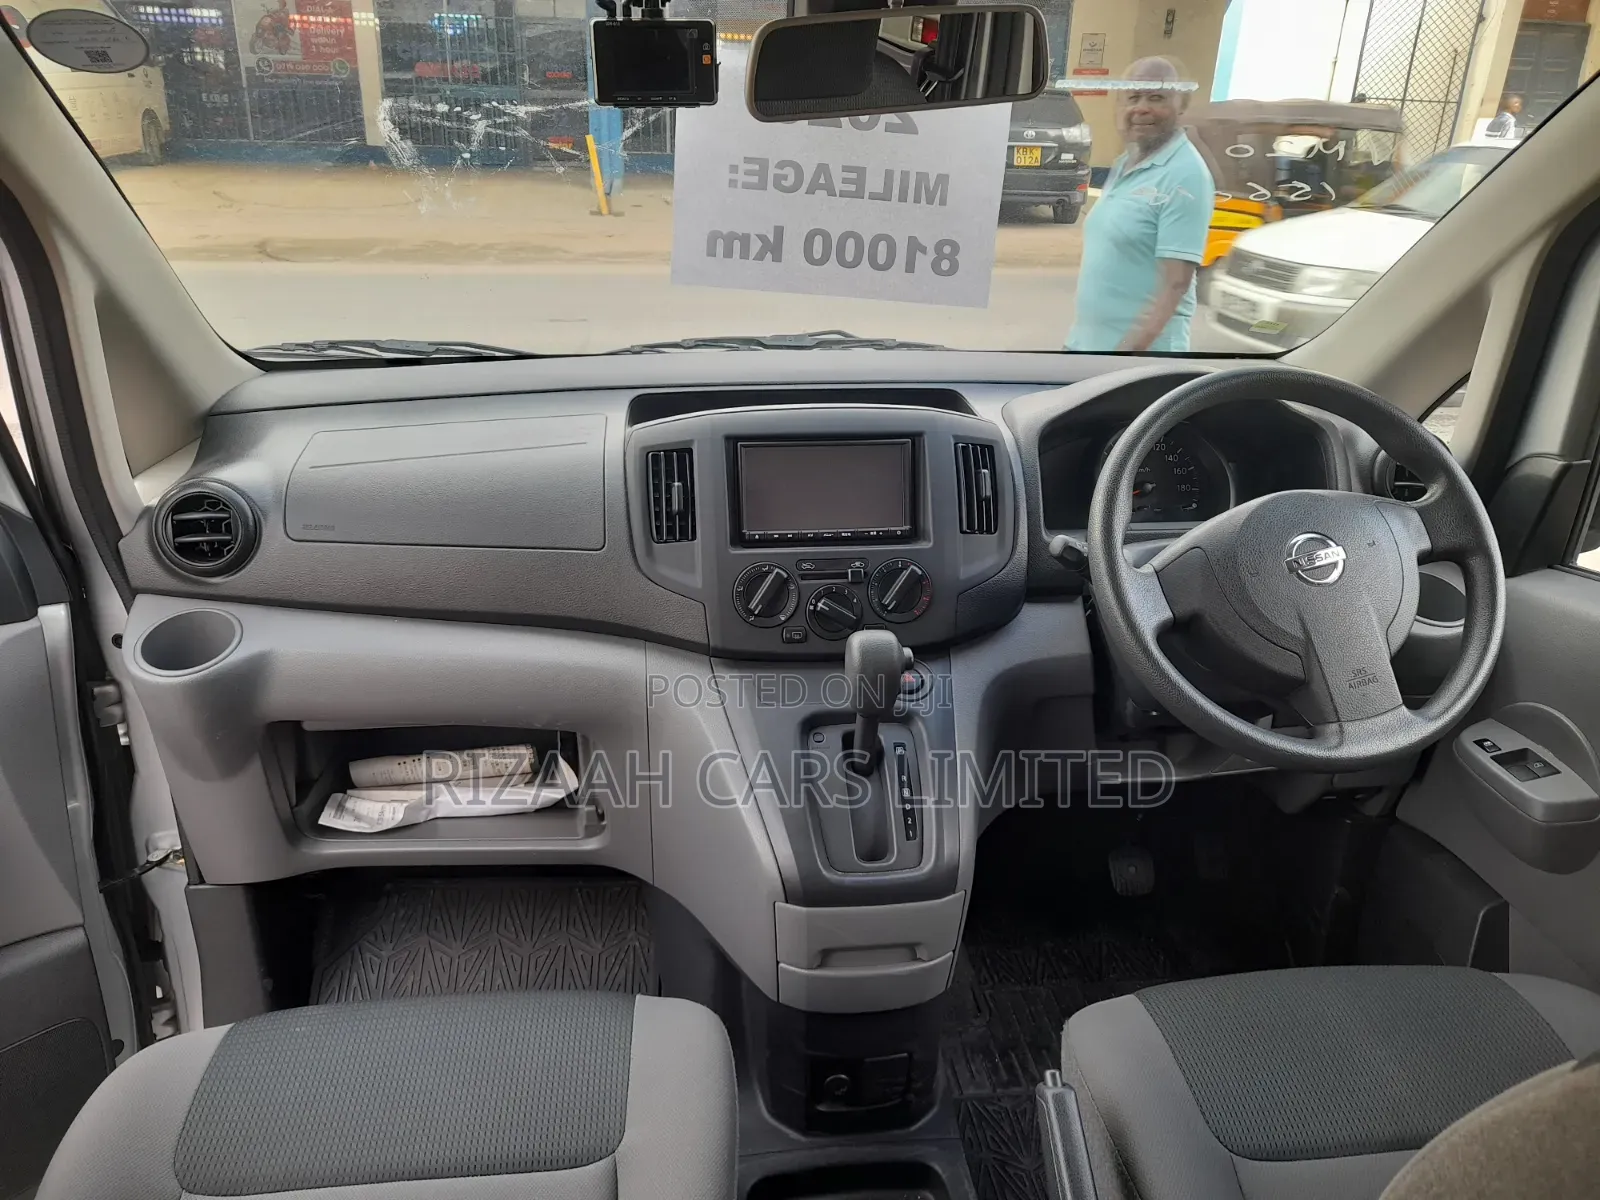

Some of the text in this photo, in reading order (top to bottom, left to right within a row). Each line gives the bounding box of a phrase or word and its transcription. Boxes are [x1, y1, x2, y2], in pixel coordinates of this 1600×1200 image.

[1016, 146, 1035, 156] KBK
[1016, 156, 1040, 165] 012A
[1153, 443, 1166, 451] 120
[1165, 454, 1179, 462] 140
[1173, 467, 1187, 475] 160
[1177, 484, 1191, 492] 180
[1292, 549, 1341, 569] NISSAN
[1351, 667, 1367, 678] SRS
[1348, 675, 1379, 690] AIRBAG
